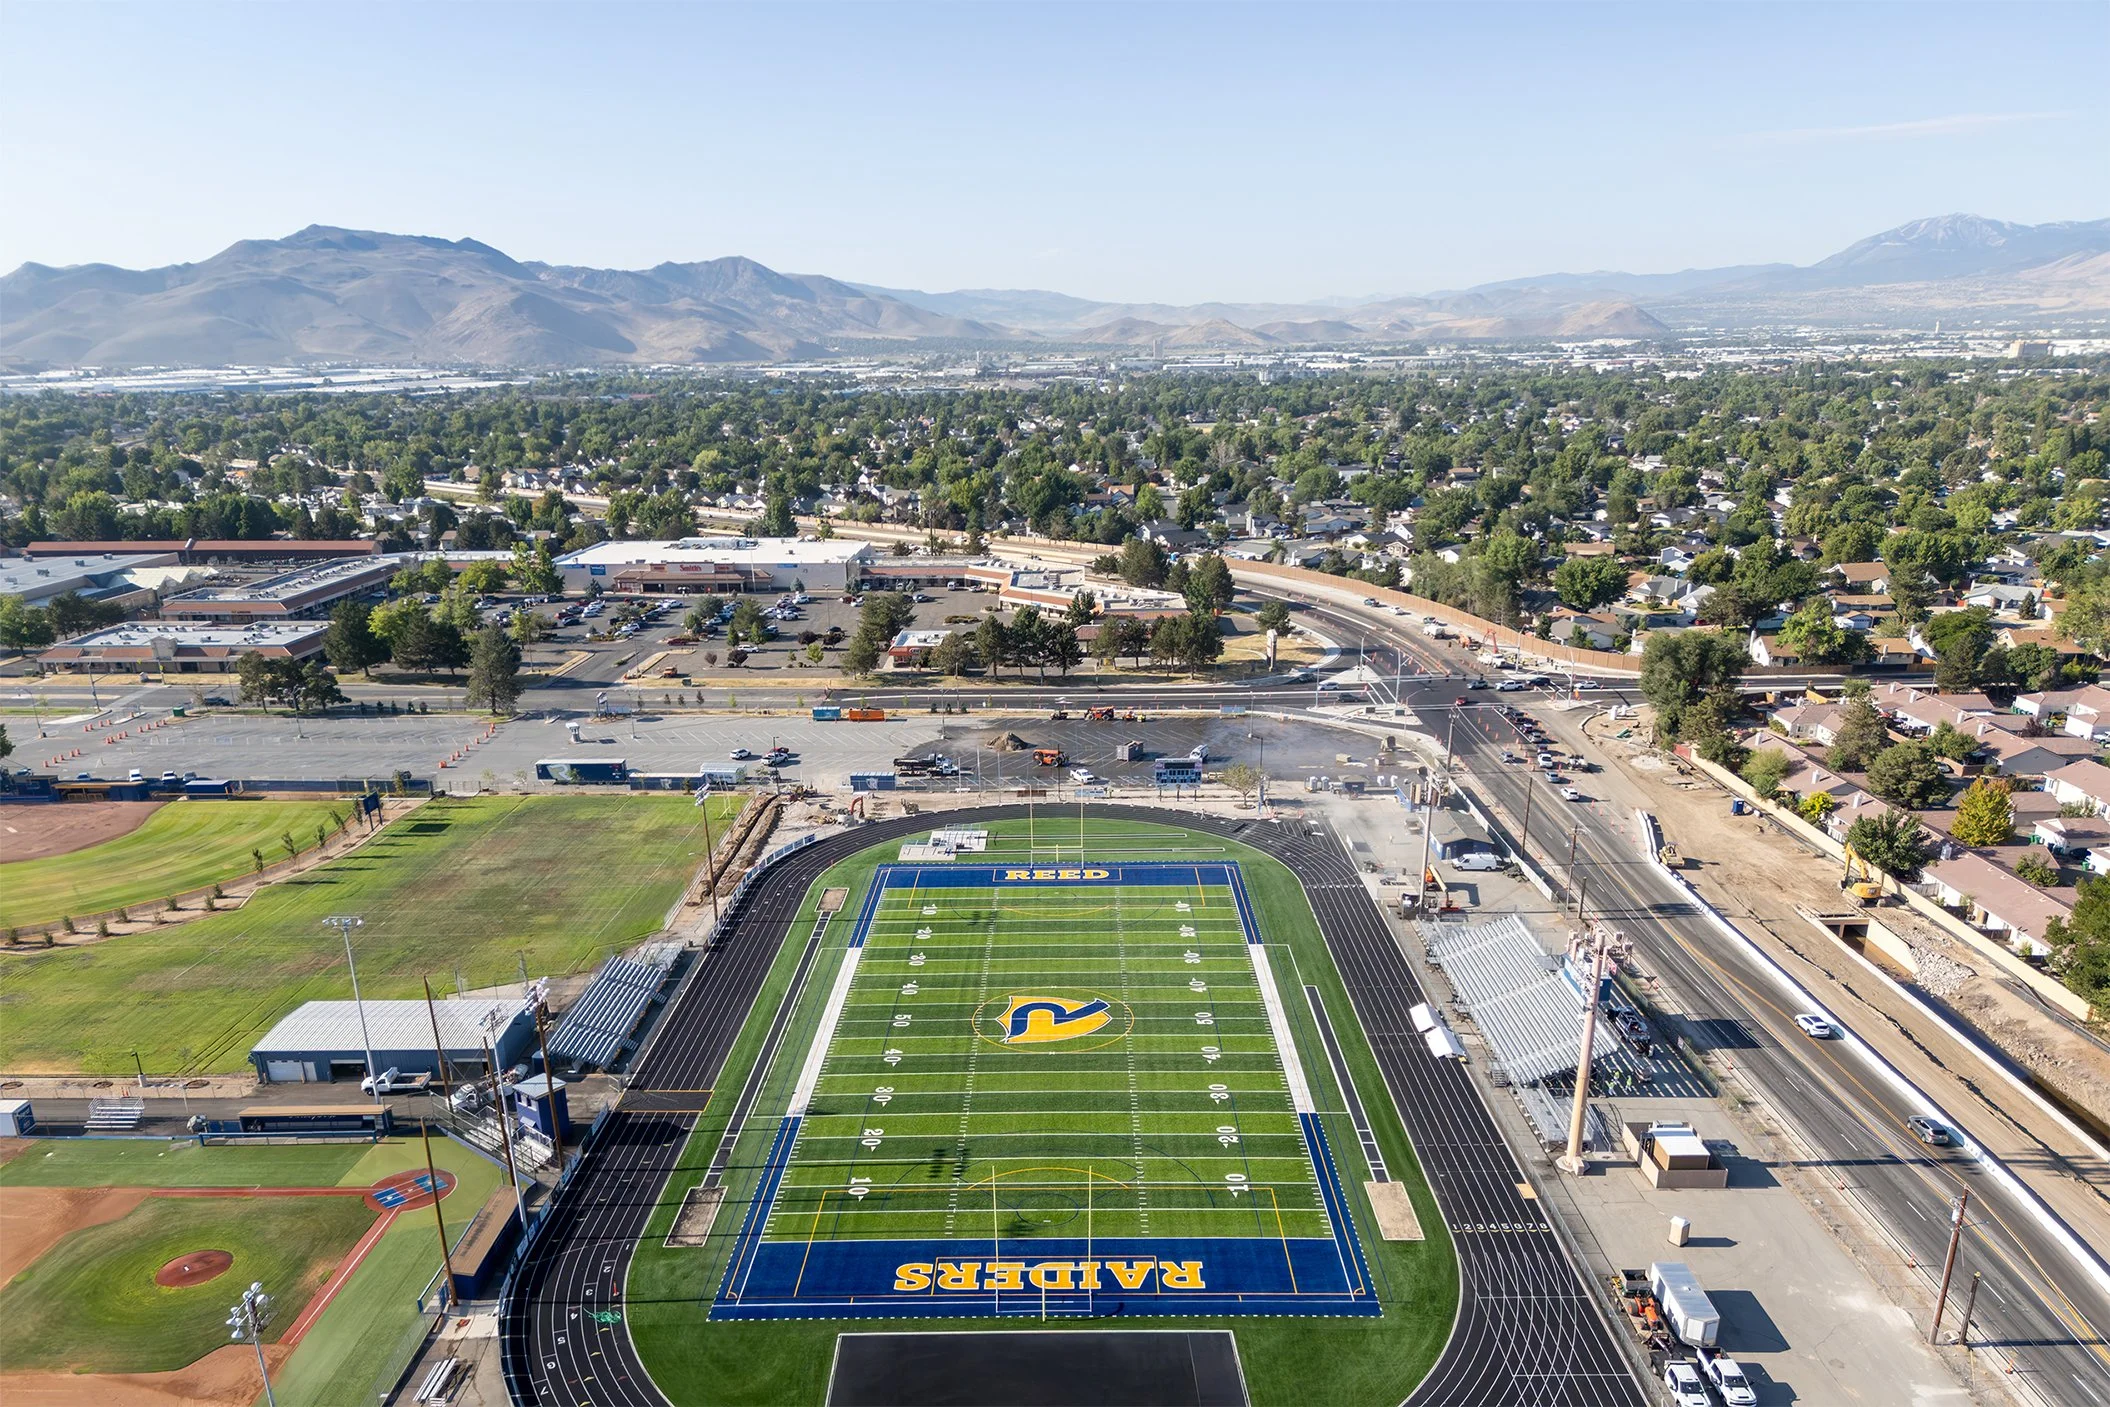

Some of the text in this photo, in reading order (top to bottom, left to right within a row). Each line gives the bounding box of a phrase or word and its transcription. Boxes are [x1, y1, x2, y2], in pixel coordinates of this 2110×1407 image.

[1005, 869, 1110, 880] REED
[892, 1014, 912, 1027] 50
[1195, 1012, 1214, 1025] 50
[883, 1048, 903, 1063] 40
[1201, 1046, 1221, 1061] 40
[872, 1086, 895, 1102] 30
[1208, 1083, 1230, 1100] 30
[861, 1128, 884, 1146] 20
[1216, 1126, 1239, 1144] 20
[848, 1176, 872, 1195] 10
[1225, 1173, 1249, 1192] 10
[893, 1261, 1206, 1291] RAIDERS
